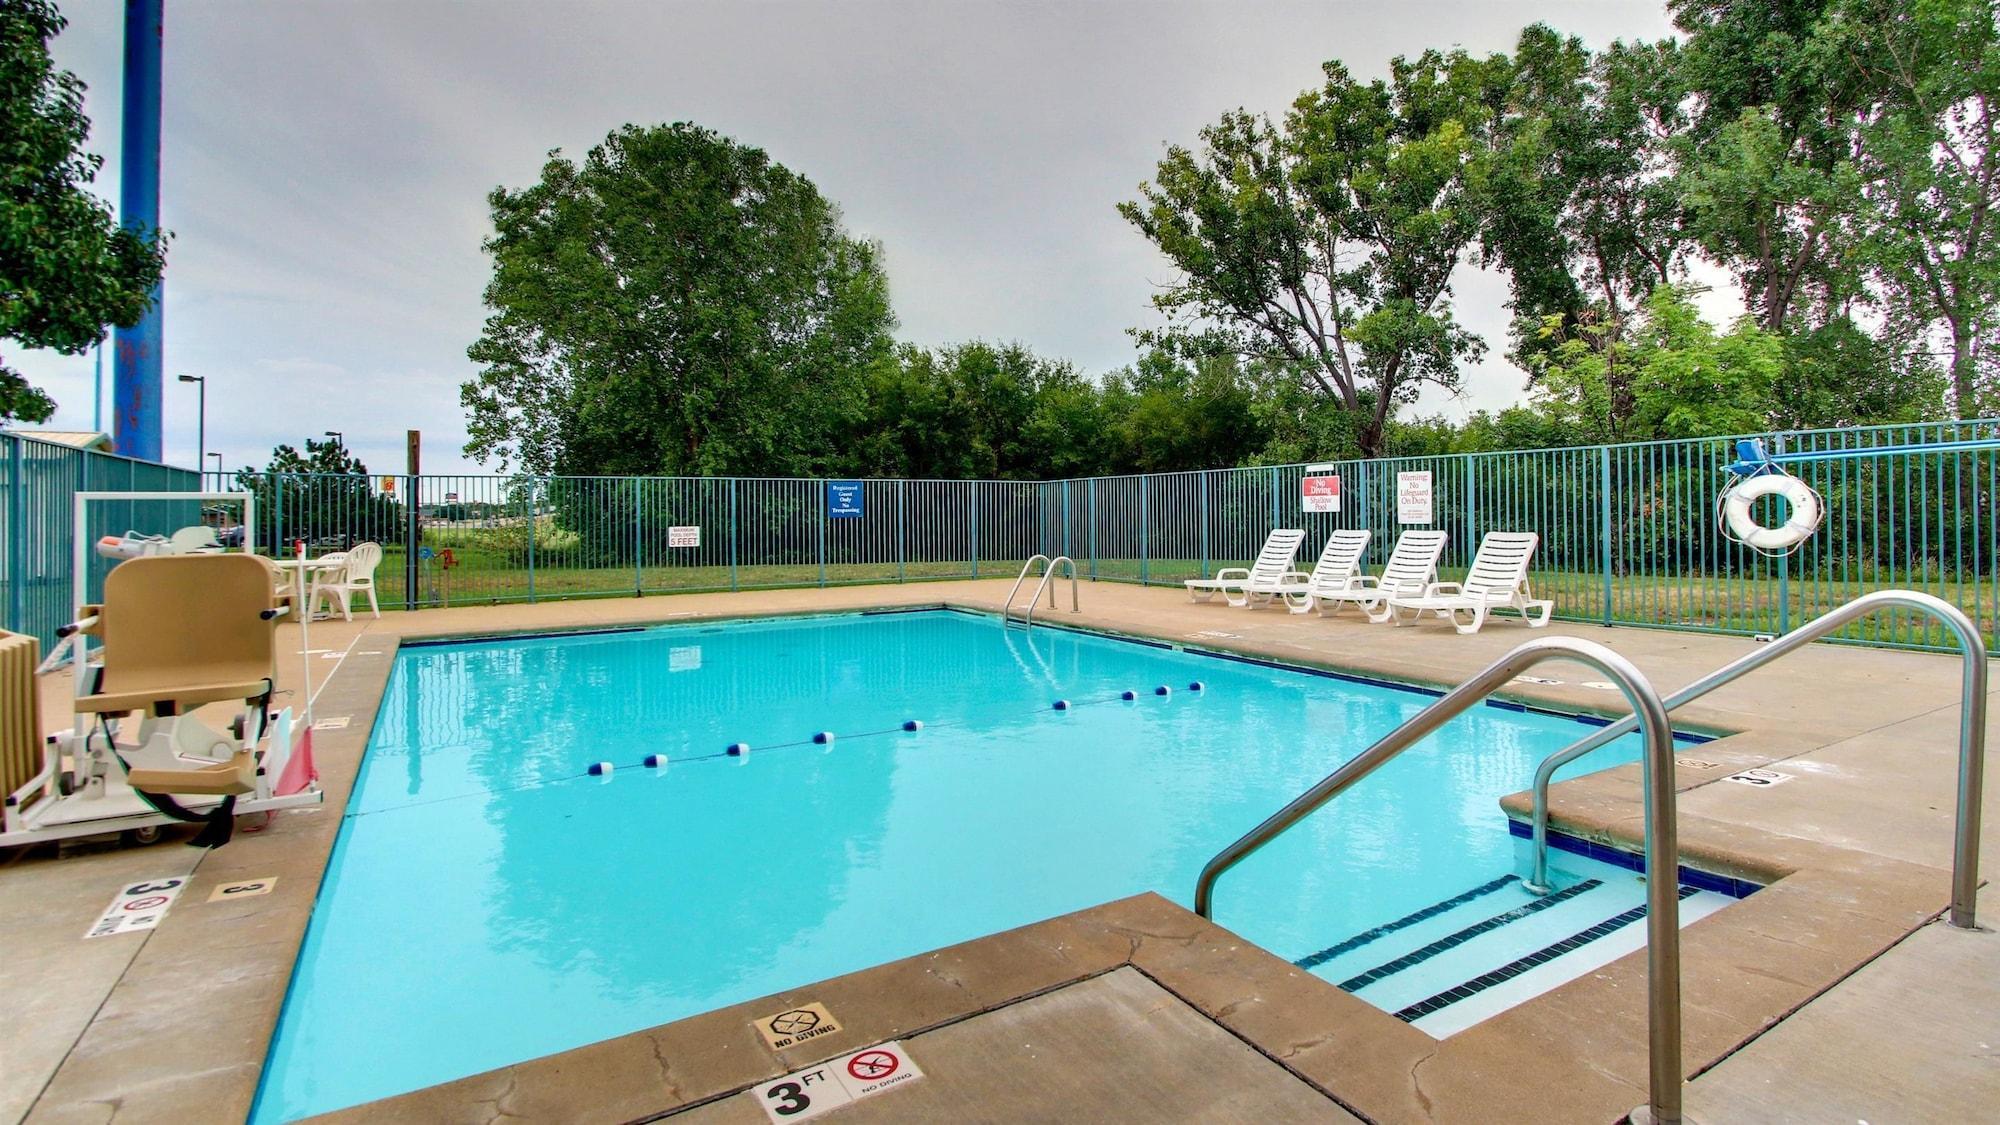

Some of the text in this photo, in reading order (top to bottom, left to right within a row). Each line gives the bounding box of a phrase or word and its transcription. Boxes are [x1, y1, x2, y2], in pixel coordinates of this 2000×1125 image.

[1315, 479, 1326, 487] No
[1409, 481, 1420, 489] No
[1311, 487, 1332, 496] Diving
[1400, 489, 1429, 498] Lifeguard
[1401, 497, 1411, 505] On
[677, 537, 698, 545] FEET
[126, 880, 182, 895] 3
[222, 883, 265, 894] 3
[774, 1024, 836, 1048] NO DIVING
[861, 1072, 912, 1094] NO DIVING
[767, 1069, 825, 1115] 3 FT
